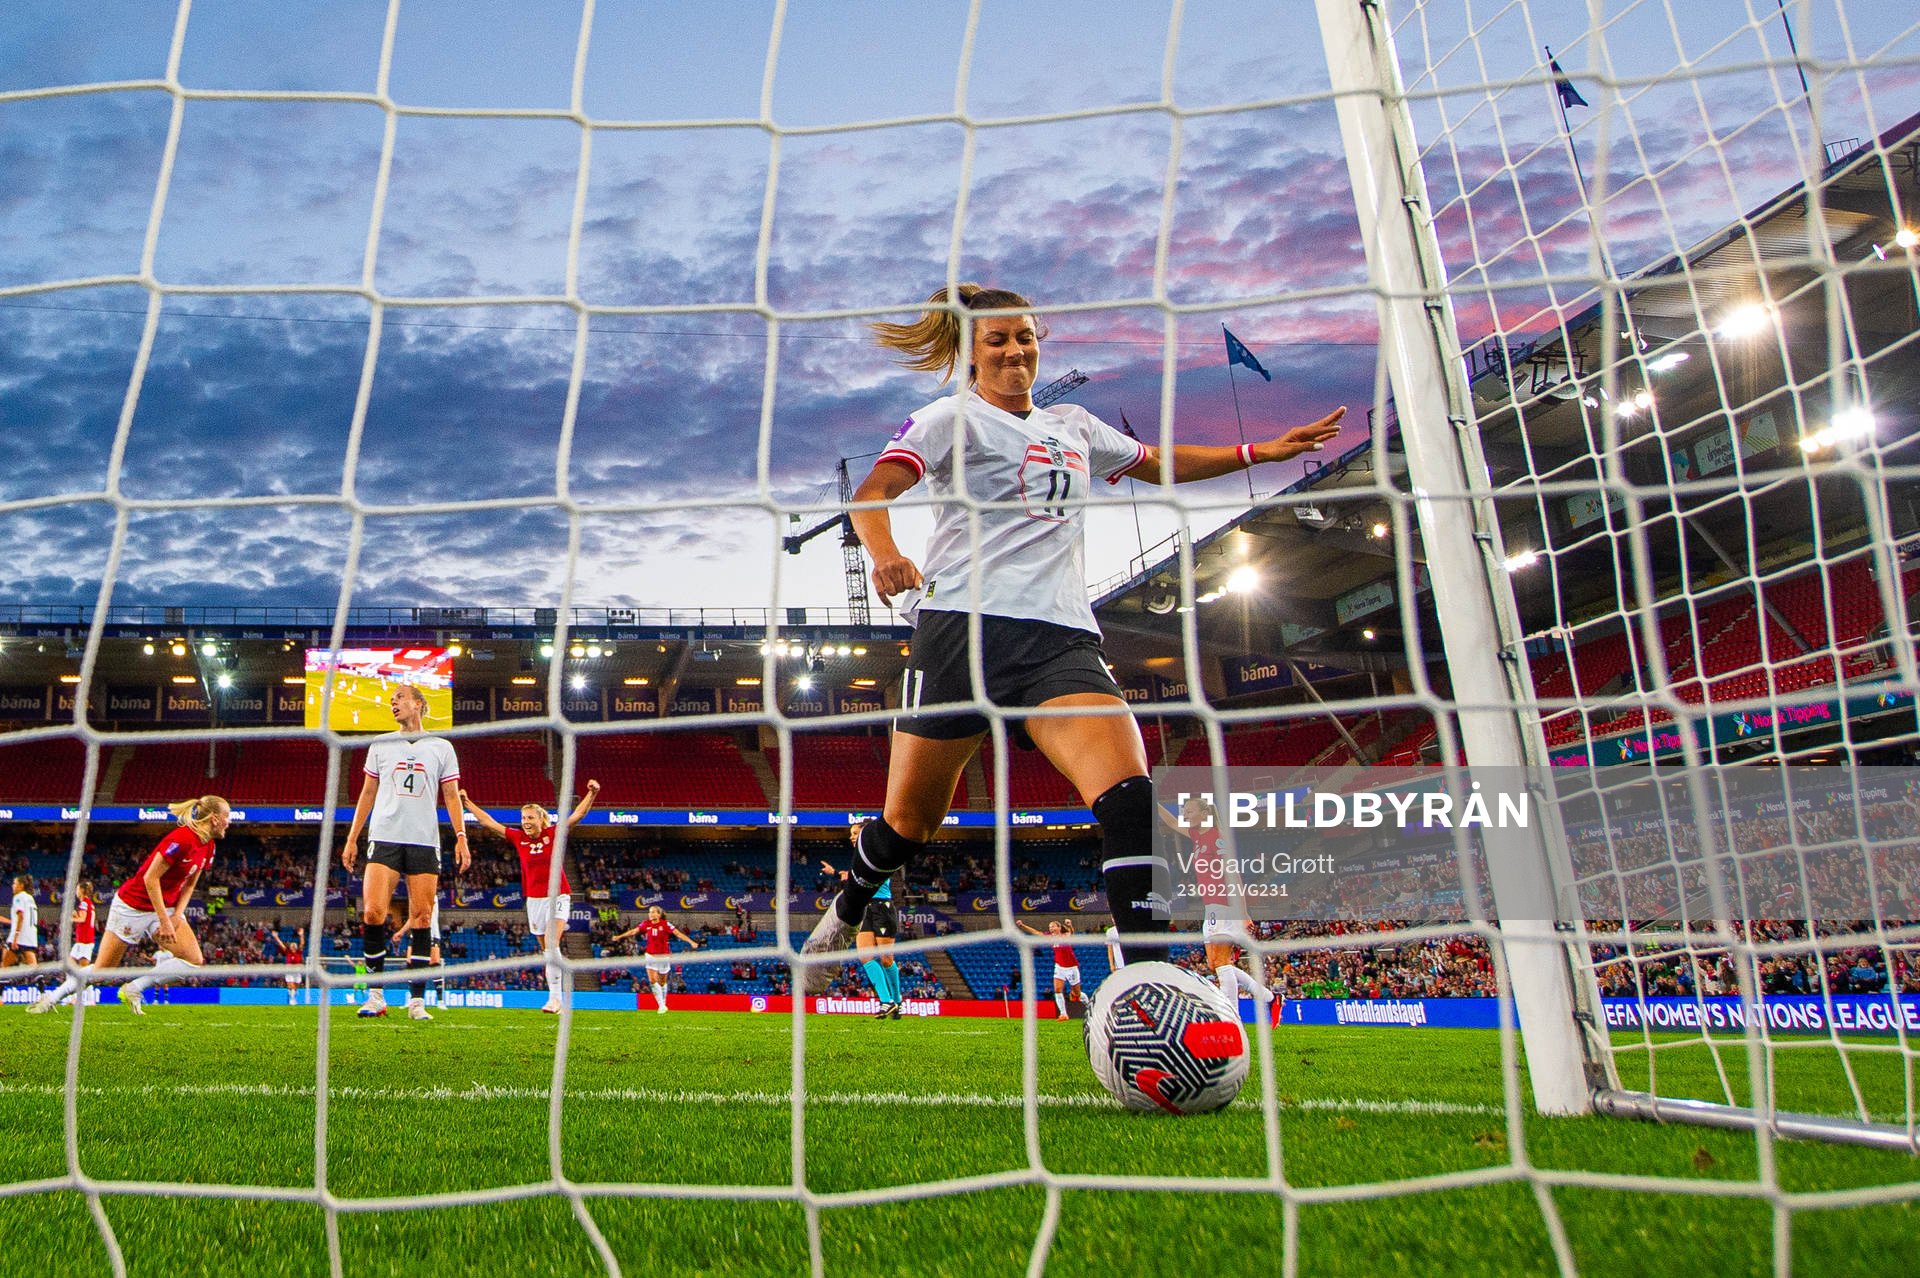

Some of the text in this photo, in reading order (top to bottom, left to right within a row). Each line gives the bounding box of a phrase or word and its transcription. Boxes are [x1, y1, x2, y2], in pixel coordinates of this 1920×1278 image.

[1046, 469, 1071, 517] 11
[492, 632, 513, 640] bama
[618, 632, 638, 641] bama
[871, 632, 892, 641] bama
[1241, 663, 1278, 683] bama
[902, 668, 924, 718] 11
[1, 695, 41, 710] bama
[110, 695, 151, 709] bama
[453, 698, 485, 711] ama
[502, 697, 543, 711] bama
[614, 697, 656, 712] bama
[1785, 703, 1831, 724] Tipping
[403, 774, 414, 793] 4
[139, 808, 168, 820] bama
[295, 809, 323, 821] bama
[609, 812, 638, 823] bama
[689, 812, 718, 824] bama
[1012, 812, 1043, 824] bama
[530, 843, 544, 854] 22
[1028, 895, 1052, 907] Bendit
[1335, 1000, 1428, 1026] @fotballandslaget
[1637, 1003, 1724, 1028] WOMEN'S
[1829, 1003, 1919, 1031] LEAGUE
